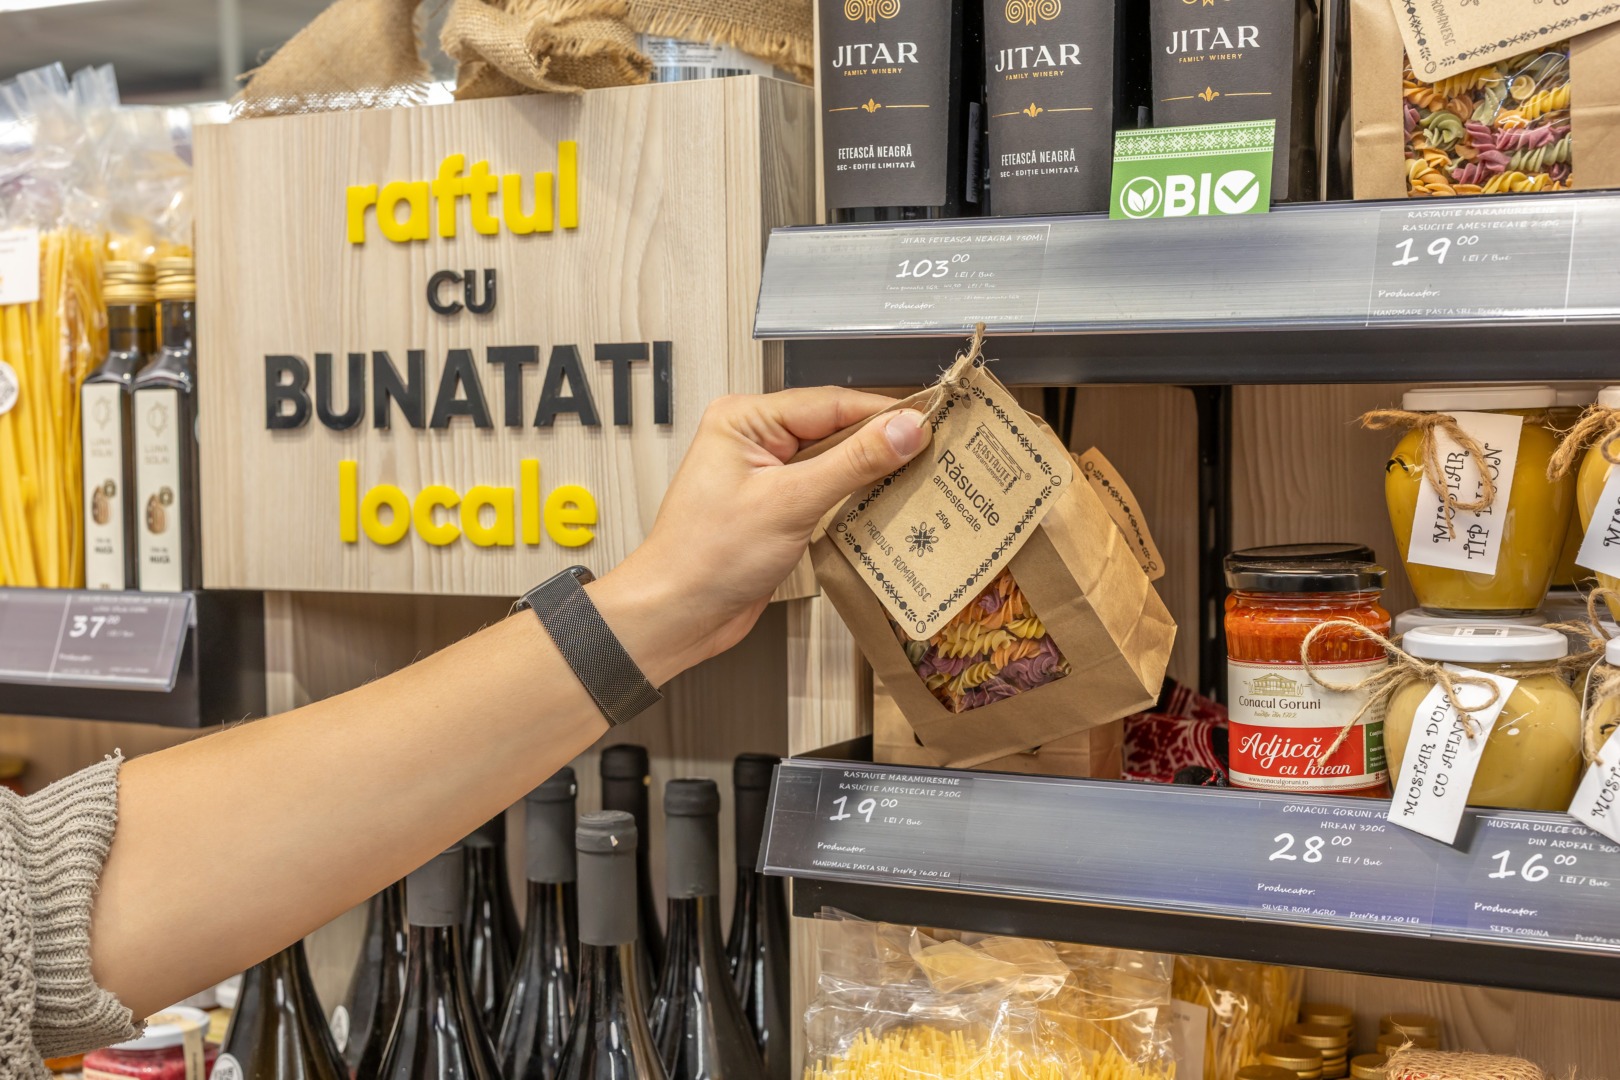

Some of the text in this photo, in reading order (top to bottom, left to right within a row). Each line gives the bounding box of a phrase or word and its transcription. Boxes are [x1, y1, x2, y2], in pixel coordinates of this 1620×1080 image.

[1166, 25, 1261, 55] JITAR
[832, 42, 919, 68] JITAR
[994, 43, 1082, 72] JITAR
[1178, 53, 1243, 63] FAMILY WINERY
[871, 67, 903, 75] WINERY
[1005, 70, 1064, 81] FAMILY WINERY
[838, 143, 913, 160] FETEASCĂ NEAGRĂ
[1001, 147, 1076, 167] FETEASCĂ NEAGRĂ
[878, 160, 916, 169] LIMITATĂ
[1000, 170, 1011, 178] SEC
[1040, 165, 1080, 175] LIMITATĂ
[346, 140, 578, 245] raftul
[1407, 209, 1462, 219] RASTAUTE
[1402, 222, 1454, 232] RASUCITE
[900, 236, 926, 244] JITAR
[928, 235, 972, 244] FETEASCA
[975, 234, 1012, 243] NEAGRA
[1391, 235, 1479, 267] 19 00
[895, 253, 970, 278] 103 00
[426, 268, 497, 316] CU
[264, 340, 674, 431] BUNATATI
[937, 449, 1000, 527] Răsucite
[339, 458, 598, 548] locale
[933, 475, 982, 532] amestecate
[935, 509, 951, 530] 250g
[863, 519, 894, 557] PRODUS
[1463, 523, 1490, 560] TIP
[69, 614, 106, 639] 37
[1238, 695, 1321, 710] Conacul Goruni
[1238, 732, 1323, 769] Adjică
[1278, 758, 1352, 776] cu hrean
[843, 770, 961, 786] RASTAUTE MARAMURESENE
[839, 782, 962, 798] RASUCITE AMESTECATE 250G
[829, 795, 898, 823] 19 00
[1282, 805, 1329, 816] CONACUL
[1332, 808, 1372, 819] GORUNI
[884, 816, 897, 824] LEI
[1359, 824, 1386, 833] 320G
[1487, 819, 1530, 831] MUSTAR
[1533, 823, 1569, 834] DULCE
[1572, 826, 1587, 836] CU
[1268, 832, 1352, 863] 28 00
[1528, 837, 1547, 847] DIN
[812, 860, 851, 869] HANDMADE
[853, 863, 875, 871] PASTA
[1336, 855, 1352, 864] LEI
[1488, 849, 1577, 882] 16 00
[1559, 875, 1577, 884] LEI
[1261, 903, 1289, 912] SILVER
[1291, 906, 1310, 914] ROM
[1312, 908, 1336, 916] AGRO
[1515, 927, 1550, 937] CORINA
